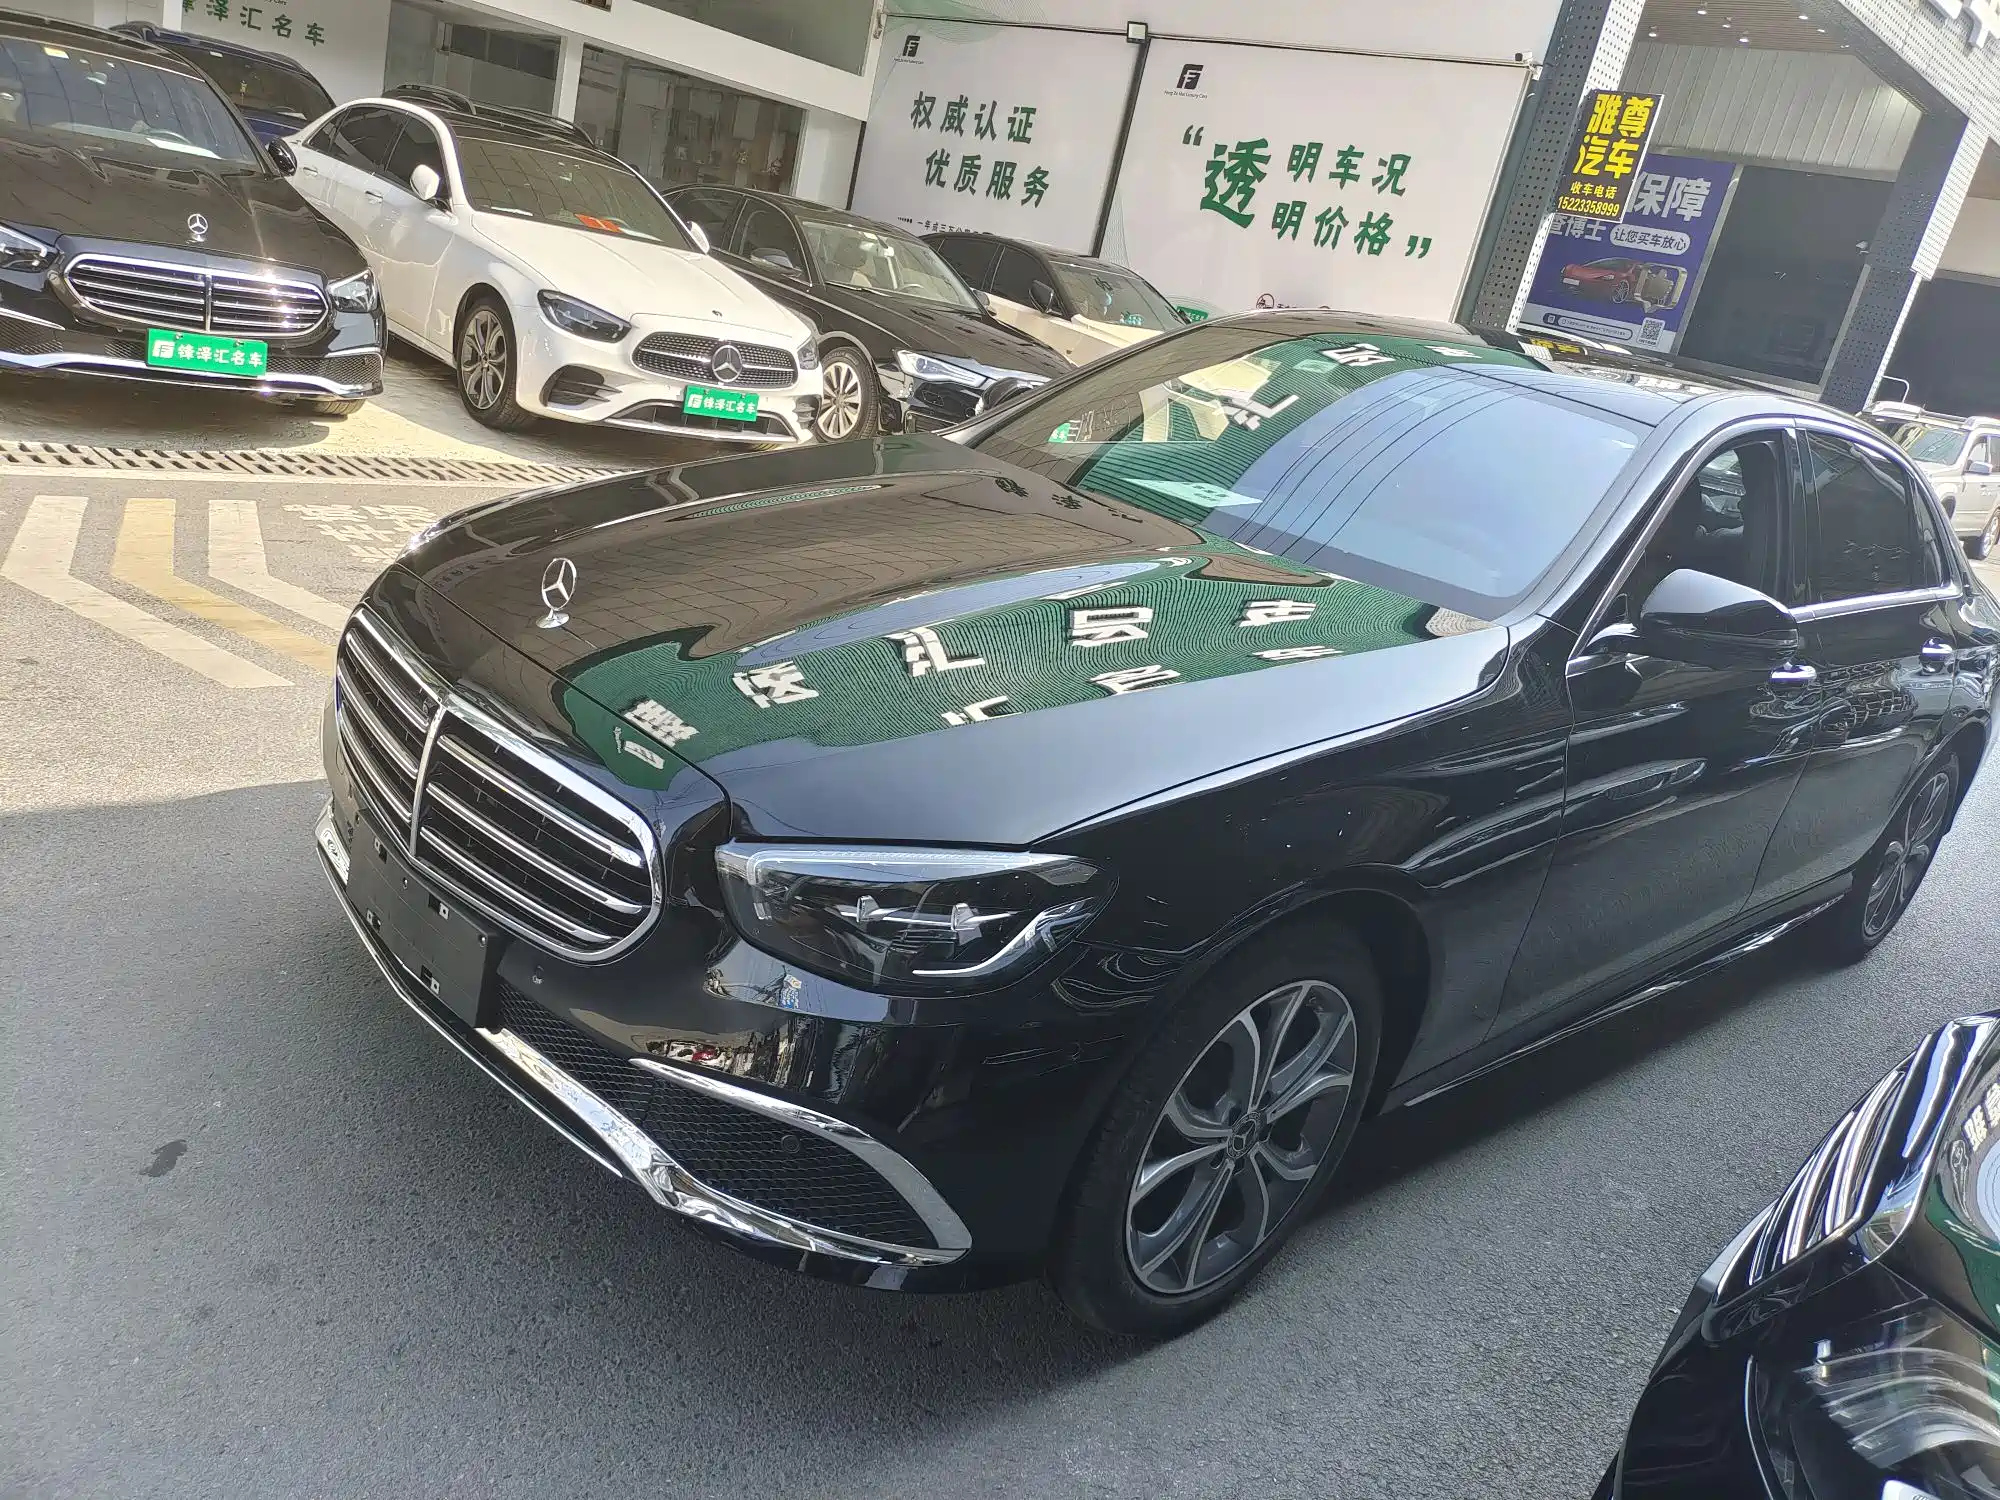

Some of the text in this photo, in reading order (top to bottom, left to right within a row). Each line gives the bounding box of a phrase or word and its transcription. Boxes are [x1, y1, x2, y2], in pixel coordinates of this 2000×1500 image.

[910, 90, 1037, 144] 权威认证
[1586, 93, 1655, 139] 雅尊
[924, 148, 1050, 208] 优质服务
[1572, 135, 1640, 180] 汽车
[1557, 196, 1620, 217] 15223358999
[1570, 181, 1618, 199] 收车电话
[1625, 171, 1712, 222] 保障
[1614, 227, 1687, 251] 让您买车放心
